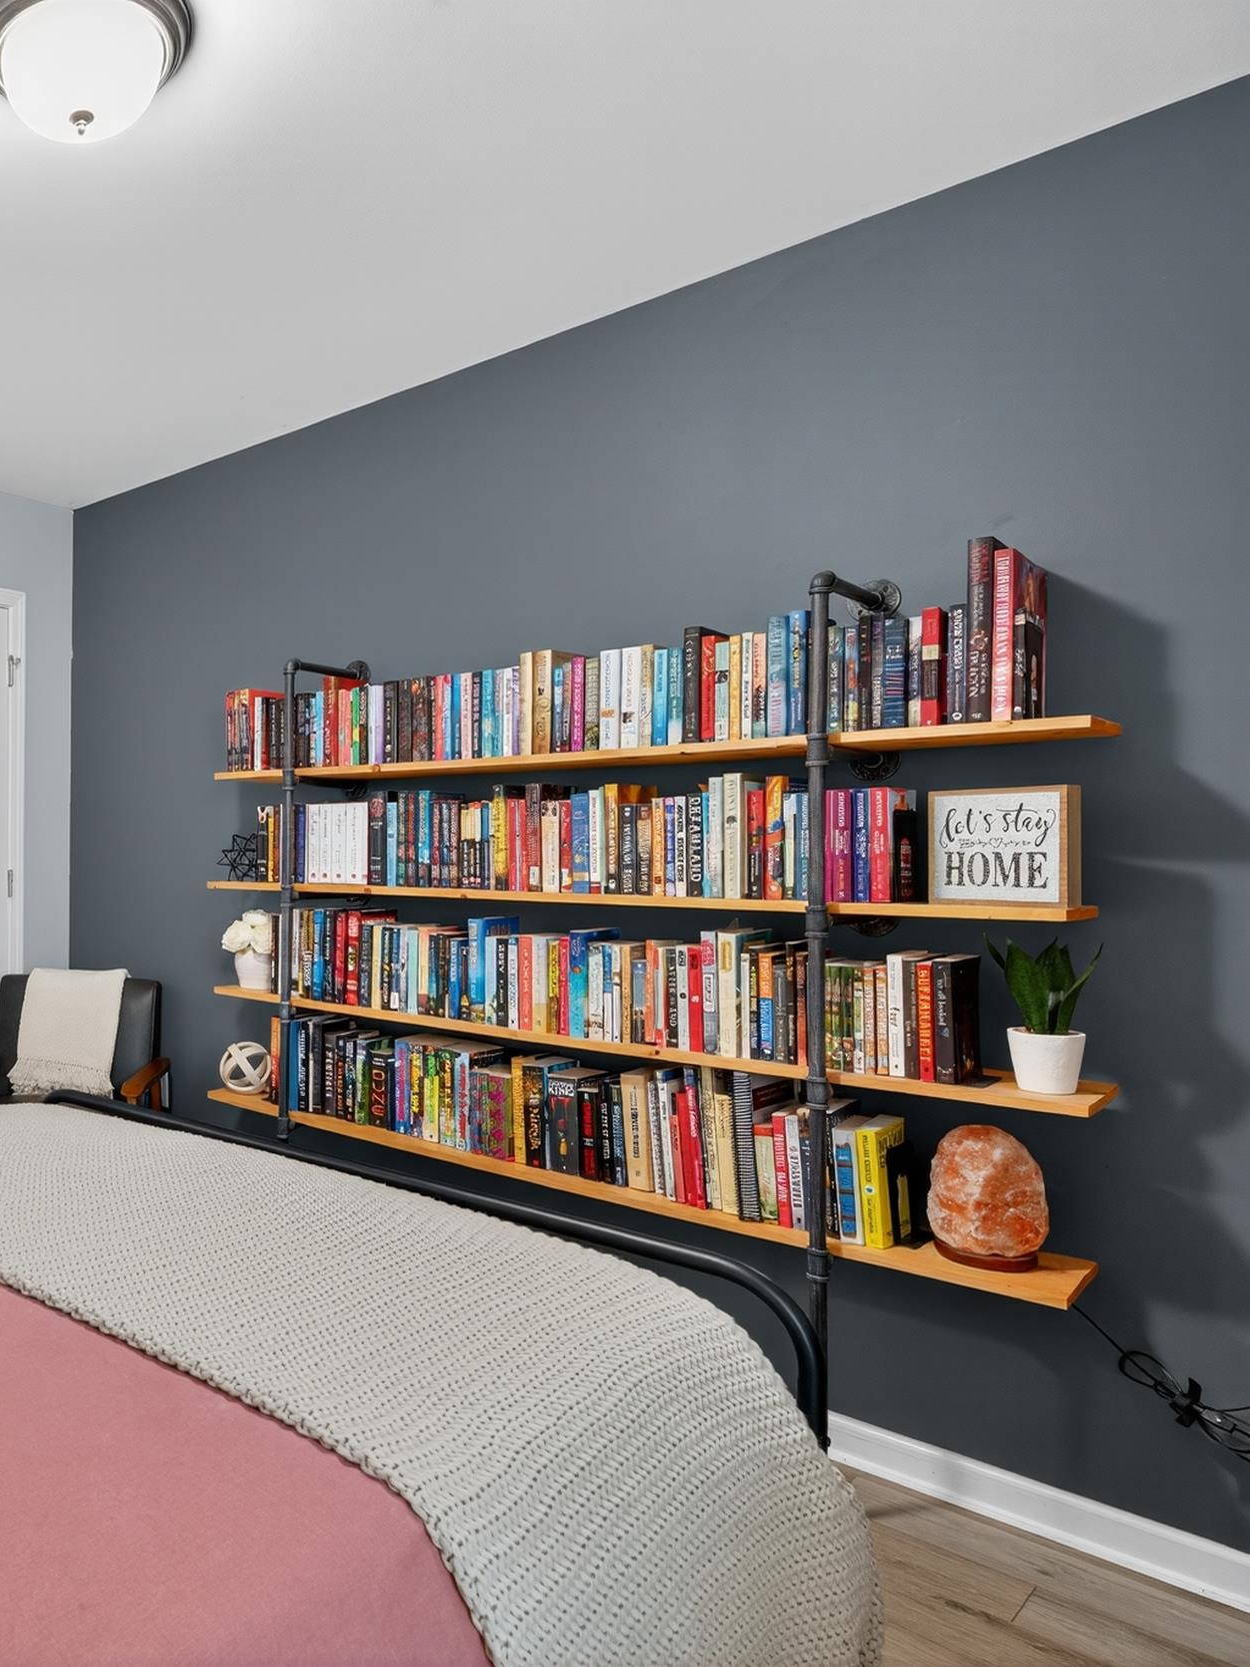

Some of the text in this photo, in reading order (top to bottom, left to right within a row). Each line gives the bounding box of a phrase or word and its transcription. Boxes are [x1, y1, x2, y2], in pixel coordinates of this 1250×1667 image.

[689, 797, 702, 882] DREAMLAND
[997, 802, 1056, 847] stay
[944, 851, 1049, 889] HOME
[918, 970, 931, 1061] SUPERMARKET
